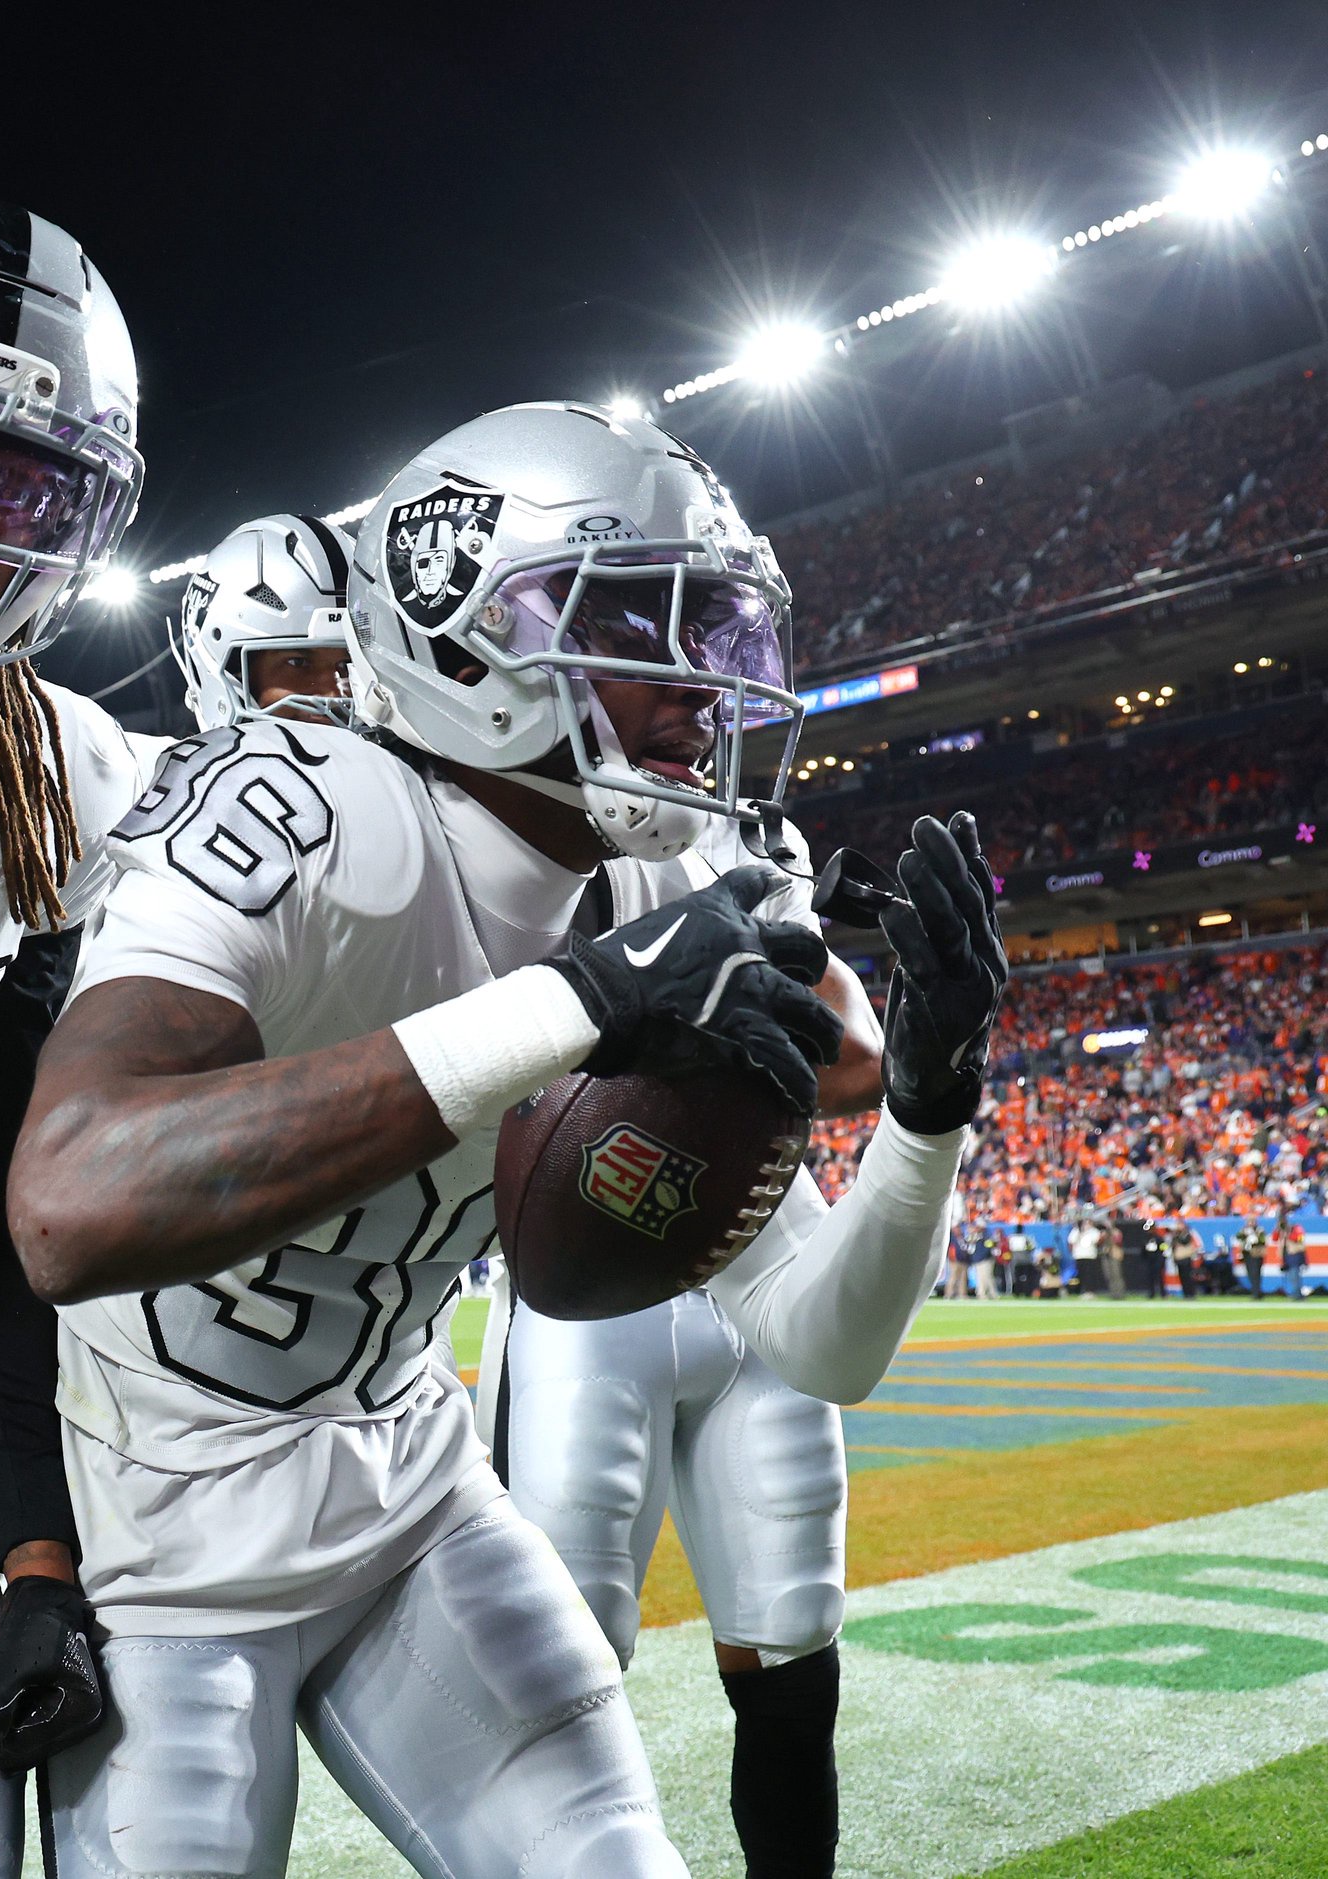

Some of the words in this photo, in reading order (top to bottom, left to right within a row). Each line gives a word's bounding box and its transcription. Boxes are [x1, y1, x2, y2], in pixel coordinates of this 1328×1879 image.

[397, 496, 492, 523] RAIDERS
[567, 531, 633, 544] OAKLEY
[589, 1132, 664, 1208] NFL
[140, 1165, 496, 1416] 3
